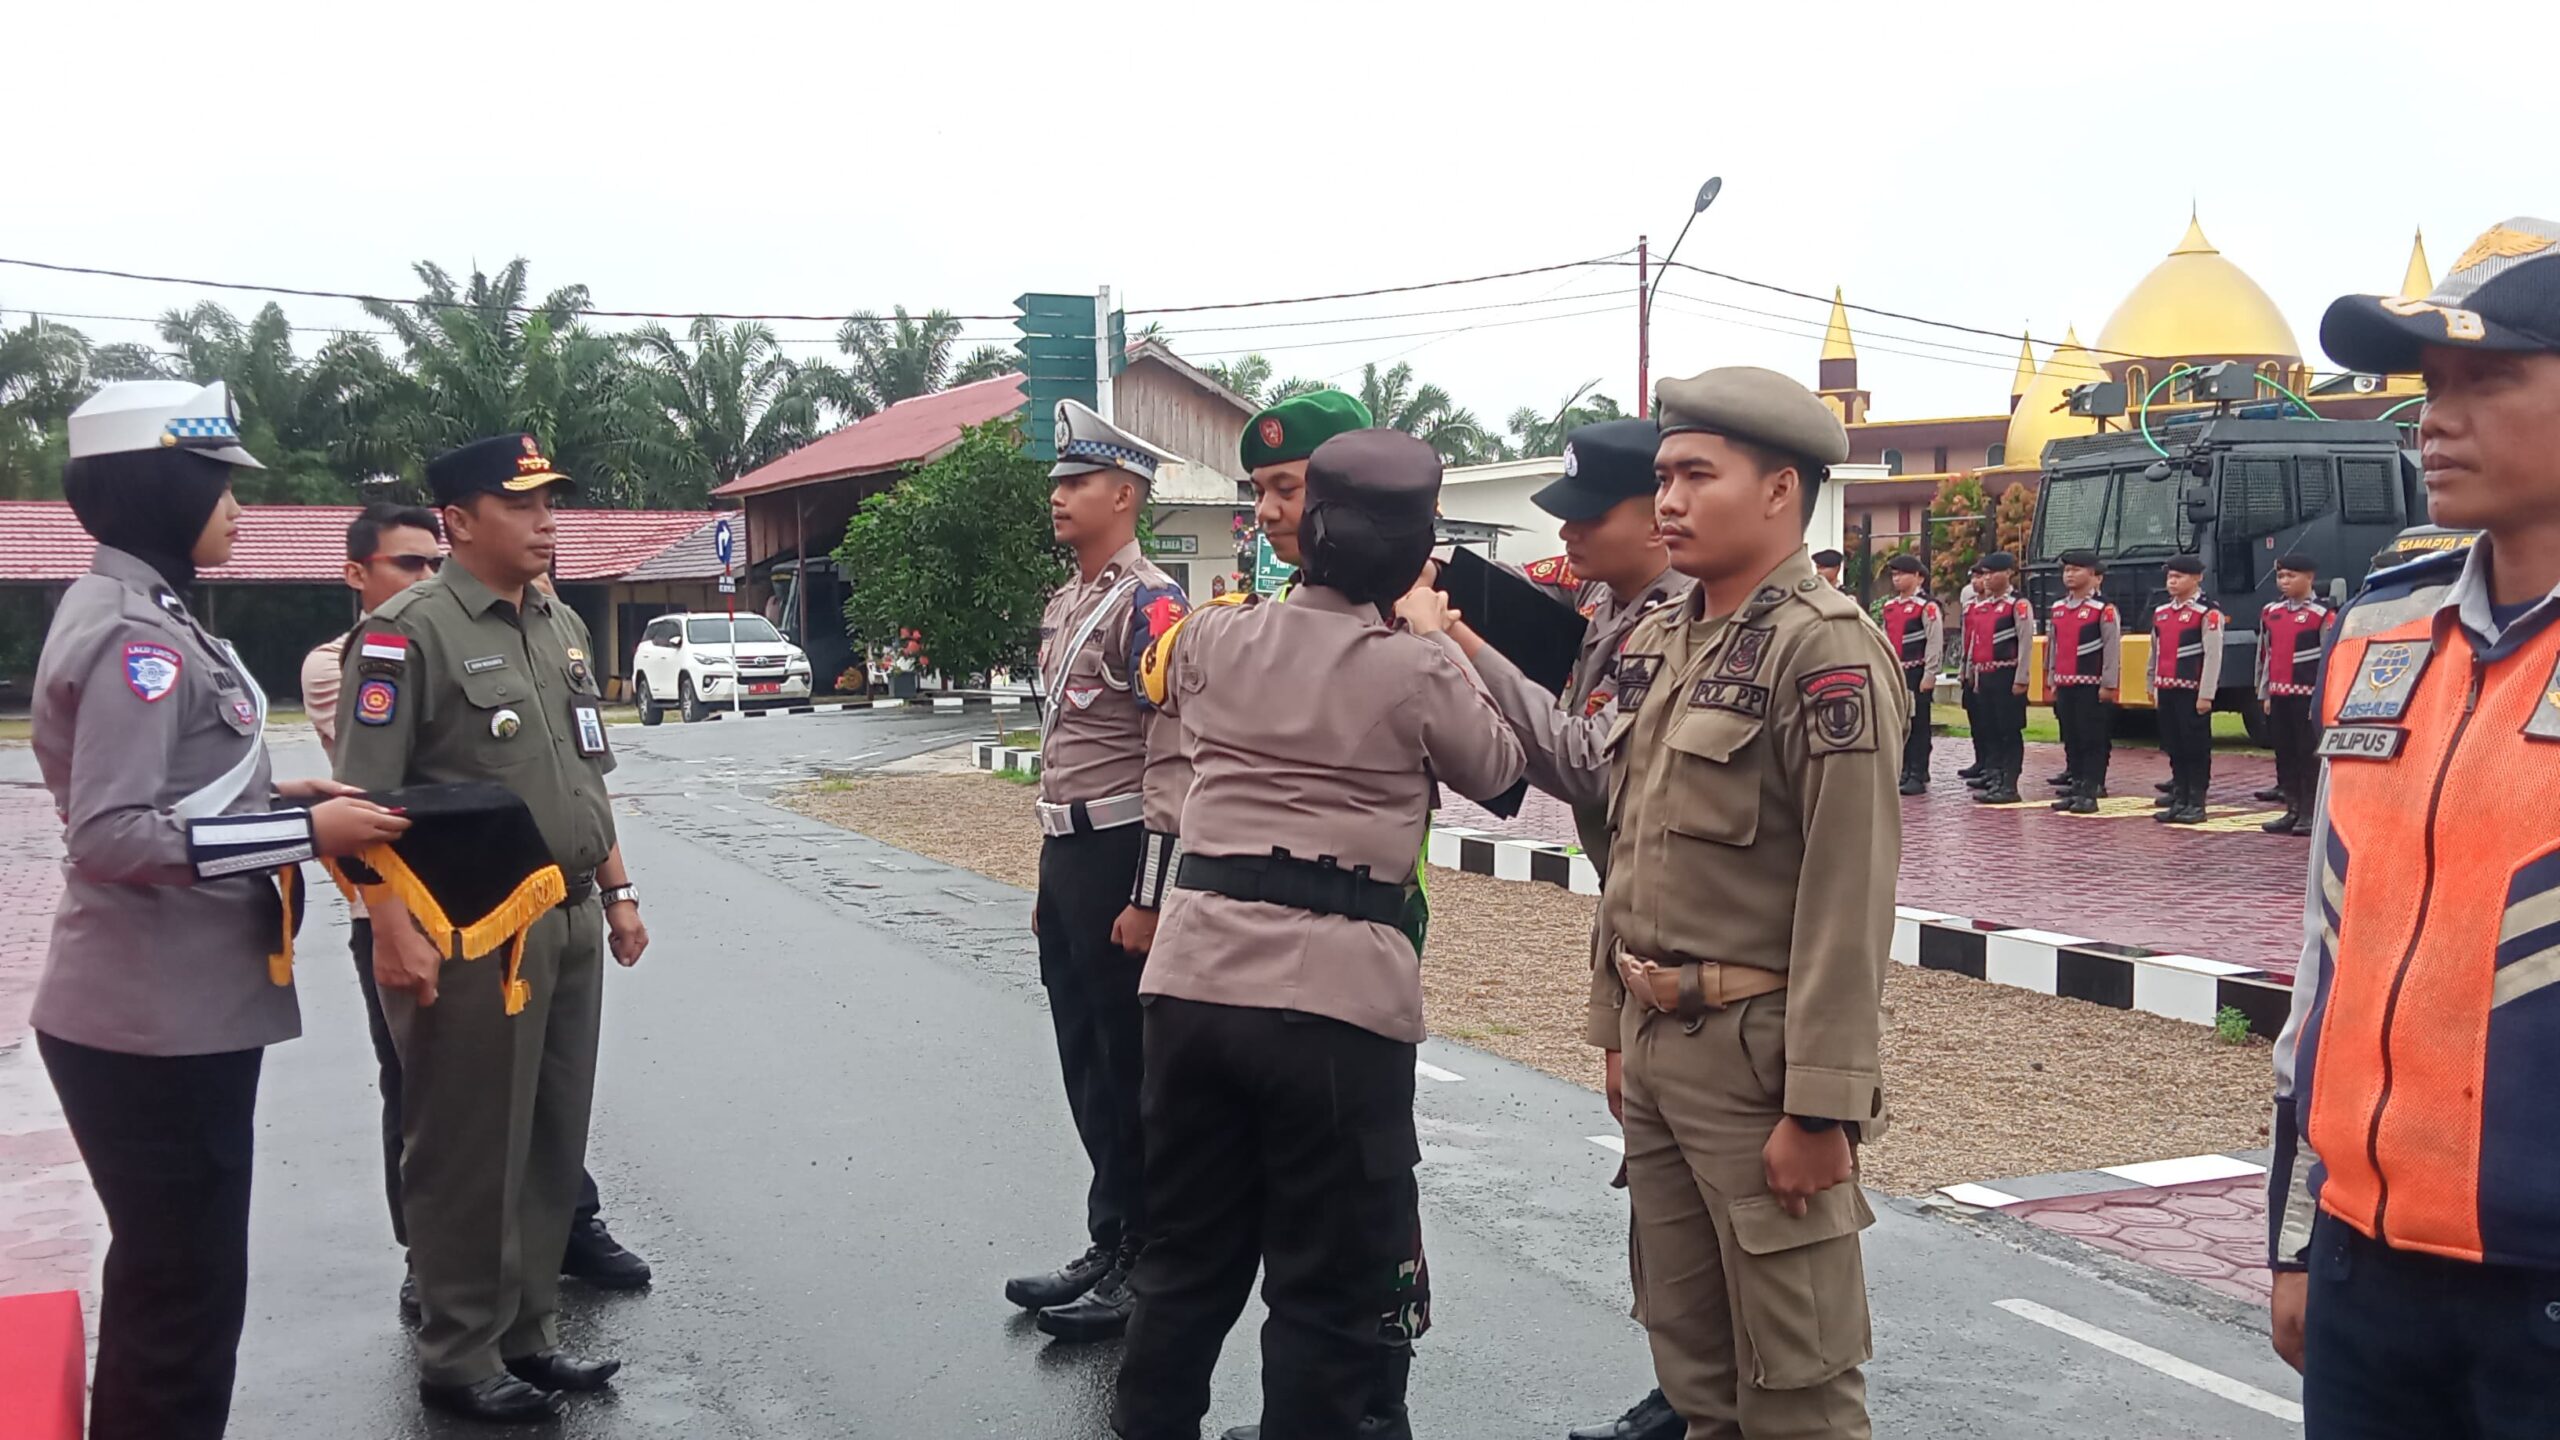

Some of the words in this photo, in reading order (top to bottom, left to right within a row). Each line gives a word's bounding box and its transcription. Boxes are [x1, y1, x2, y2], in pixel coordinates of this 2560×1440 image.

[1691, 683, 1728, 703] POL
[1732, 687, 1762, 710] PP
[2342, 702, 2399, 717] DISHUB
[2326, 733, 2387, 752] PILIPUS
